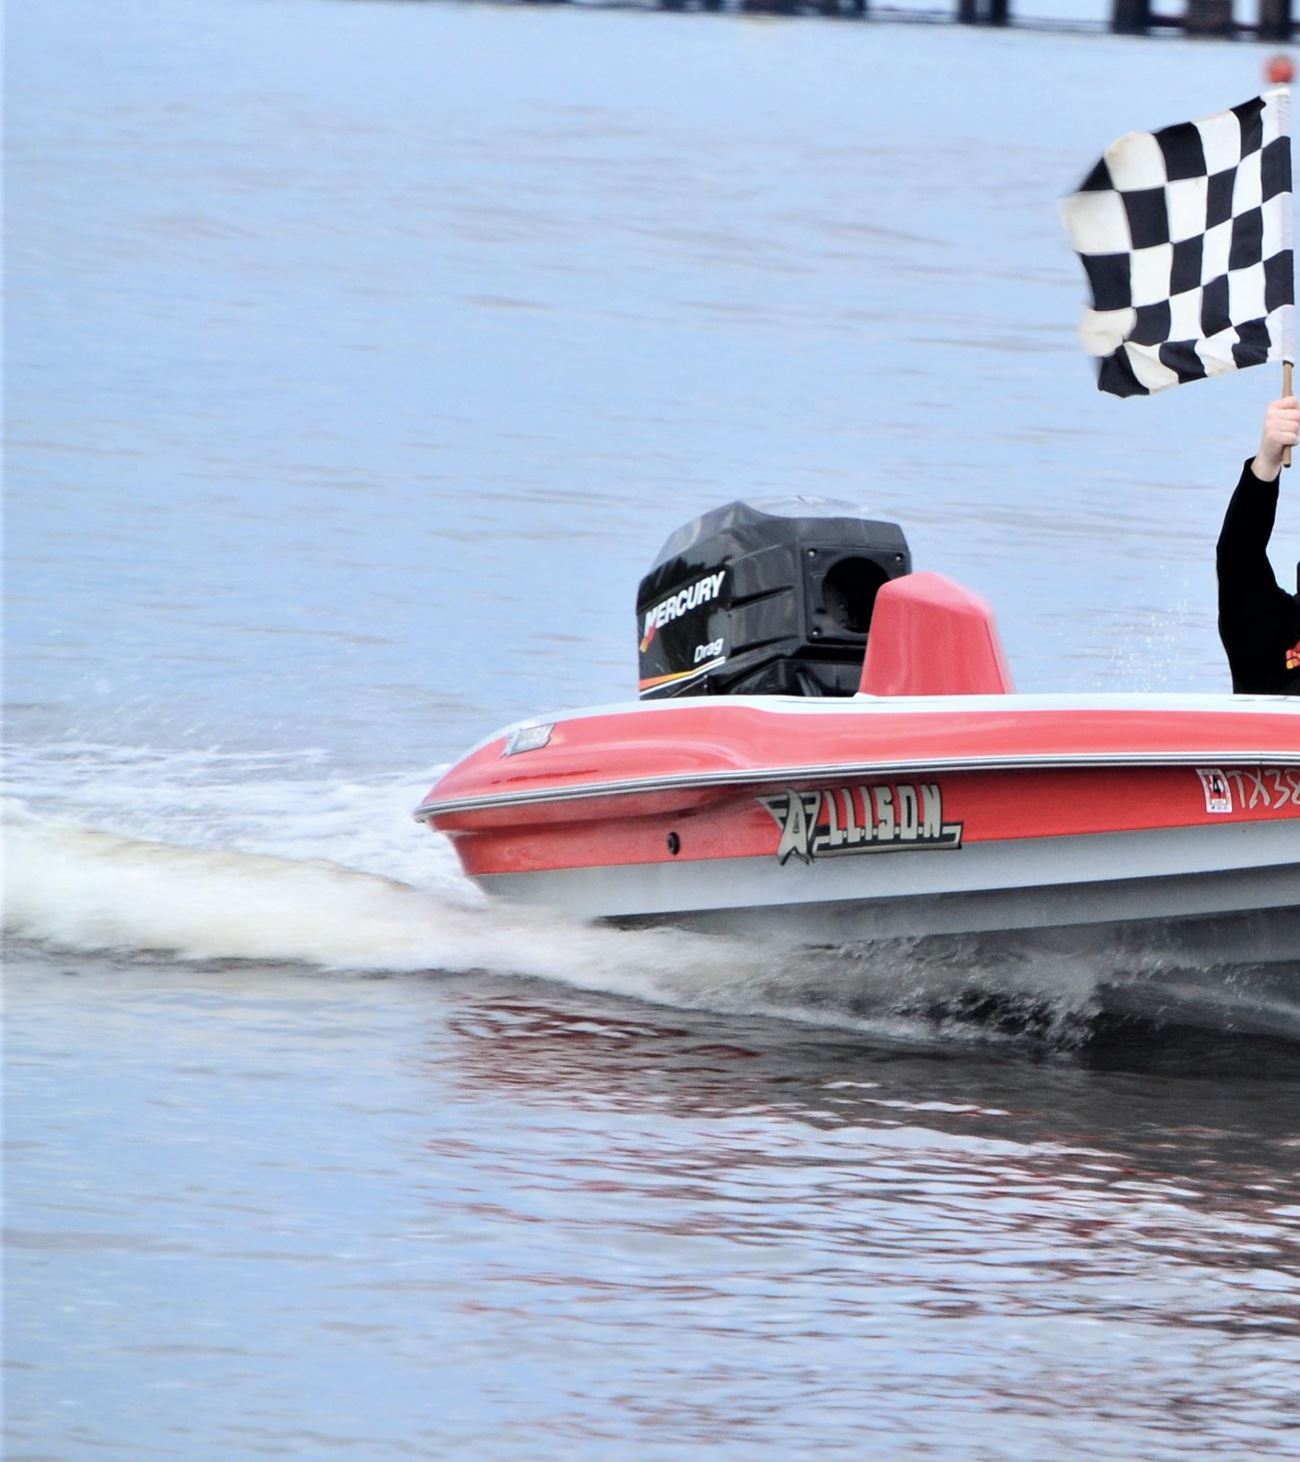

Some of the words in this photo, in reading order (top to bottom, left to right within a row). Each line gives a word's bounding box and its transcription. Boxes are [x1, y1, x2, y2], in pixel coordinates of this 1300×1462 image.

[642, 571, 725, 634] MERCURY
[694, 638, 724, 664] Drag
[757, 784, 944, 866] ALLISON
